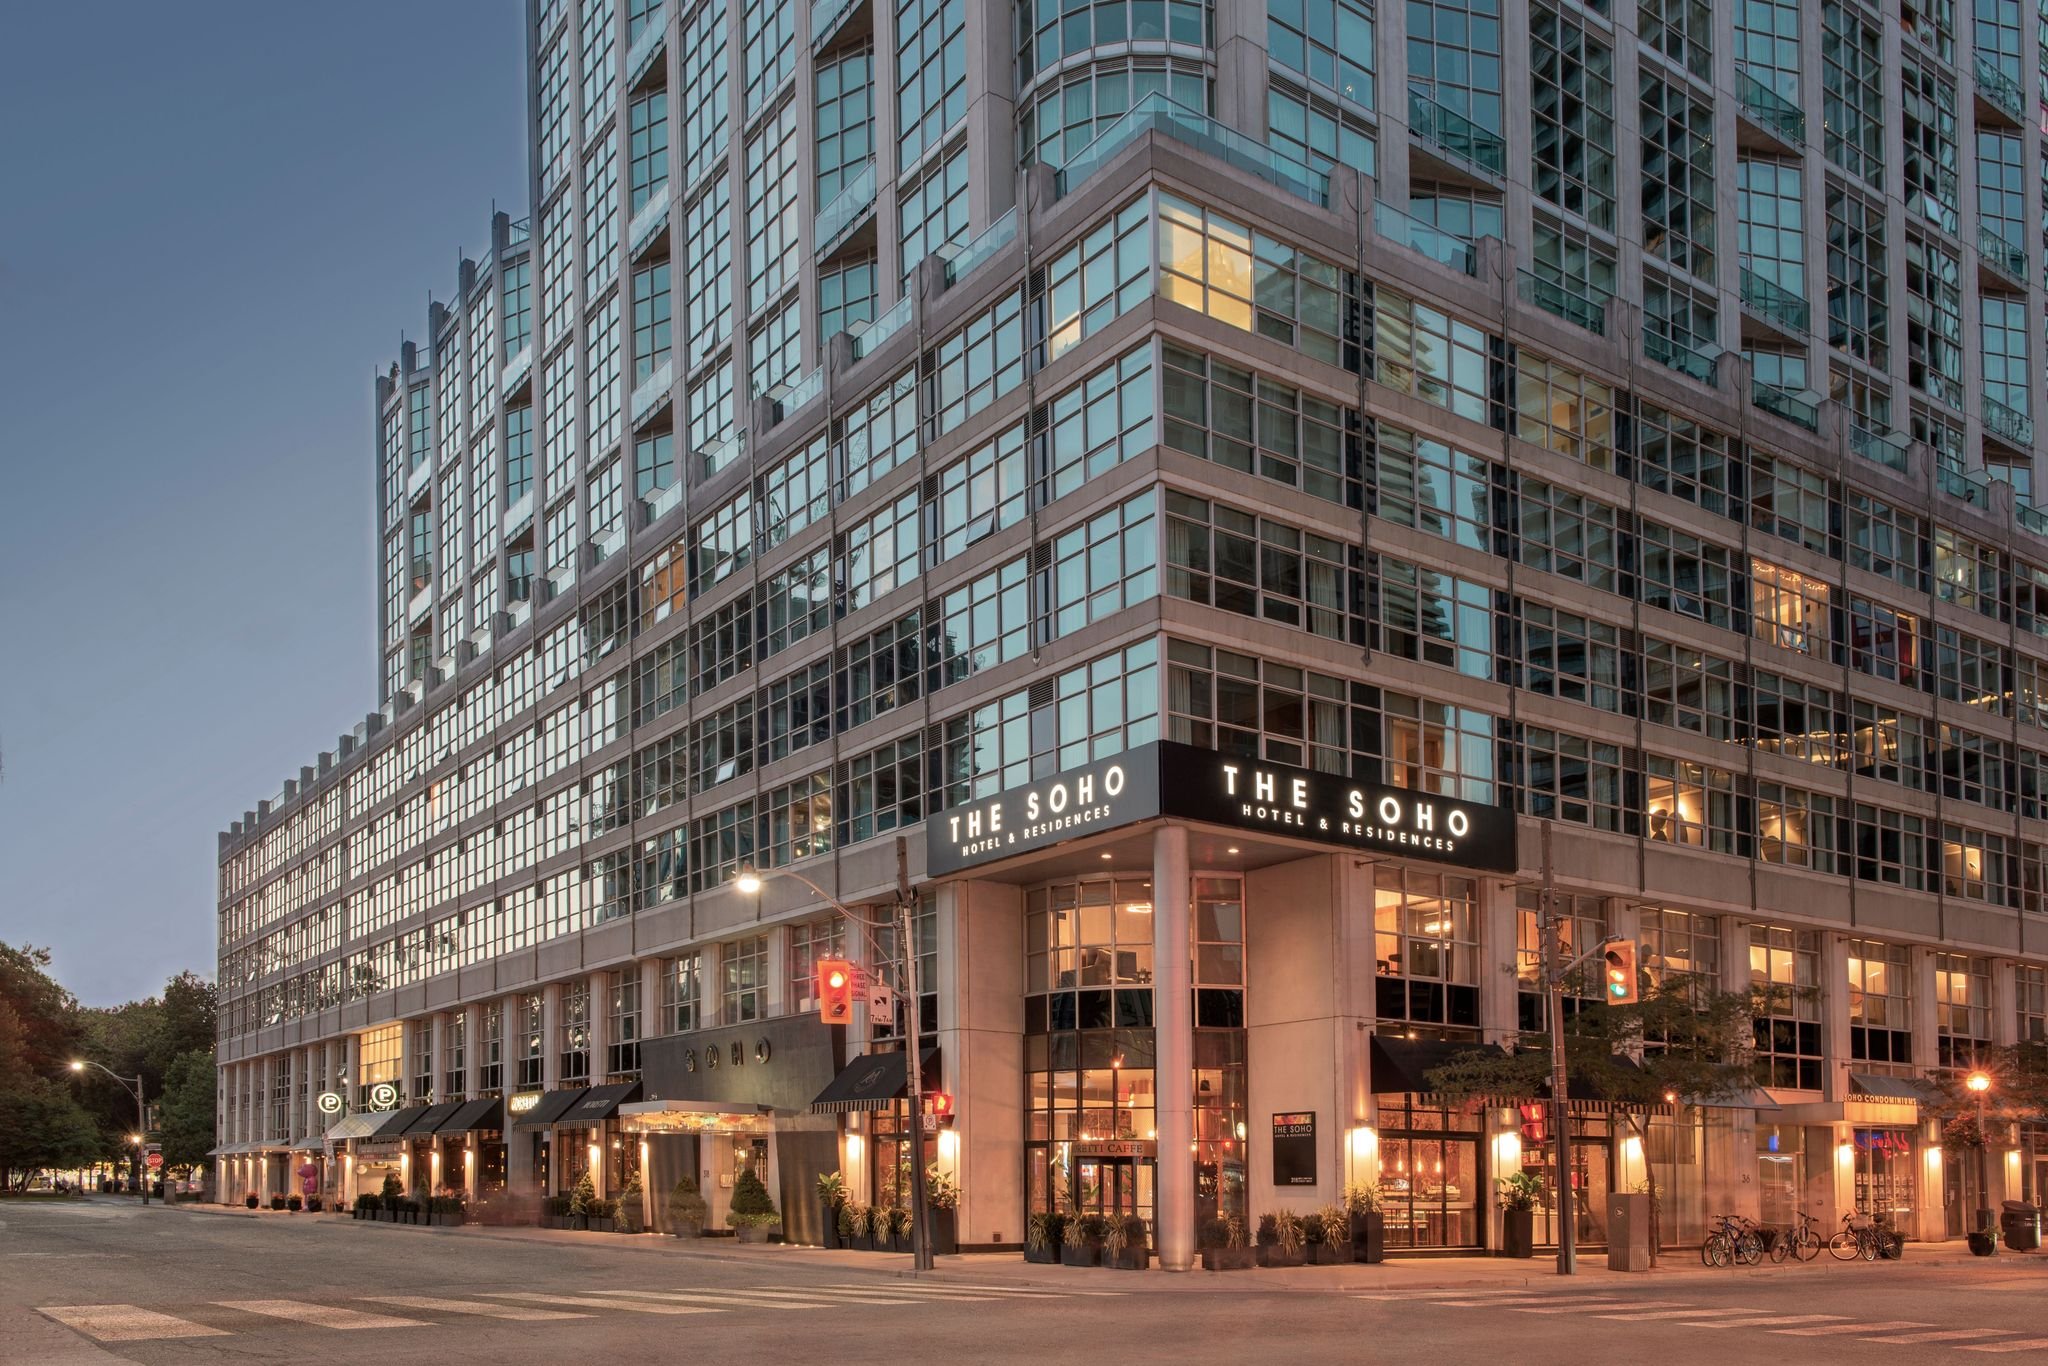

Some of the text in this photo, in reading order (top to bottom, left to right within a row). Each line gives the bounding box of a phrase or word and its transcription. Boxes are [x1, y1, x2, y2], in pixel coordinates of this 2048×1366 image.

[949, 765, 1125, 843] THE SOHO
[1223, 764, 1469, 838] THE SOHO
[962, 804, 1111, 857] HOTEL & RESIDENCES
[1242, 803, 1454, 852] HOTEL & RESIDENCES
[685, 1036, 771, 1073] SOHO
[1864, 1094, 1918, 1106] CONDOMINIUMS
[1274, 1124, 1312, 1134] THE SOHO
[1107, 1143, 1143, 1153] CAFFE
[1741, 1173, 1751, 1184] 36
